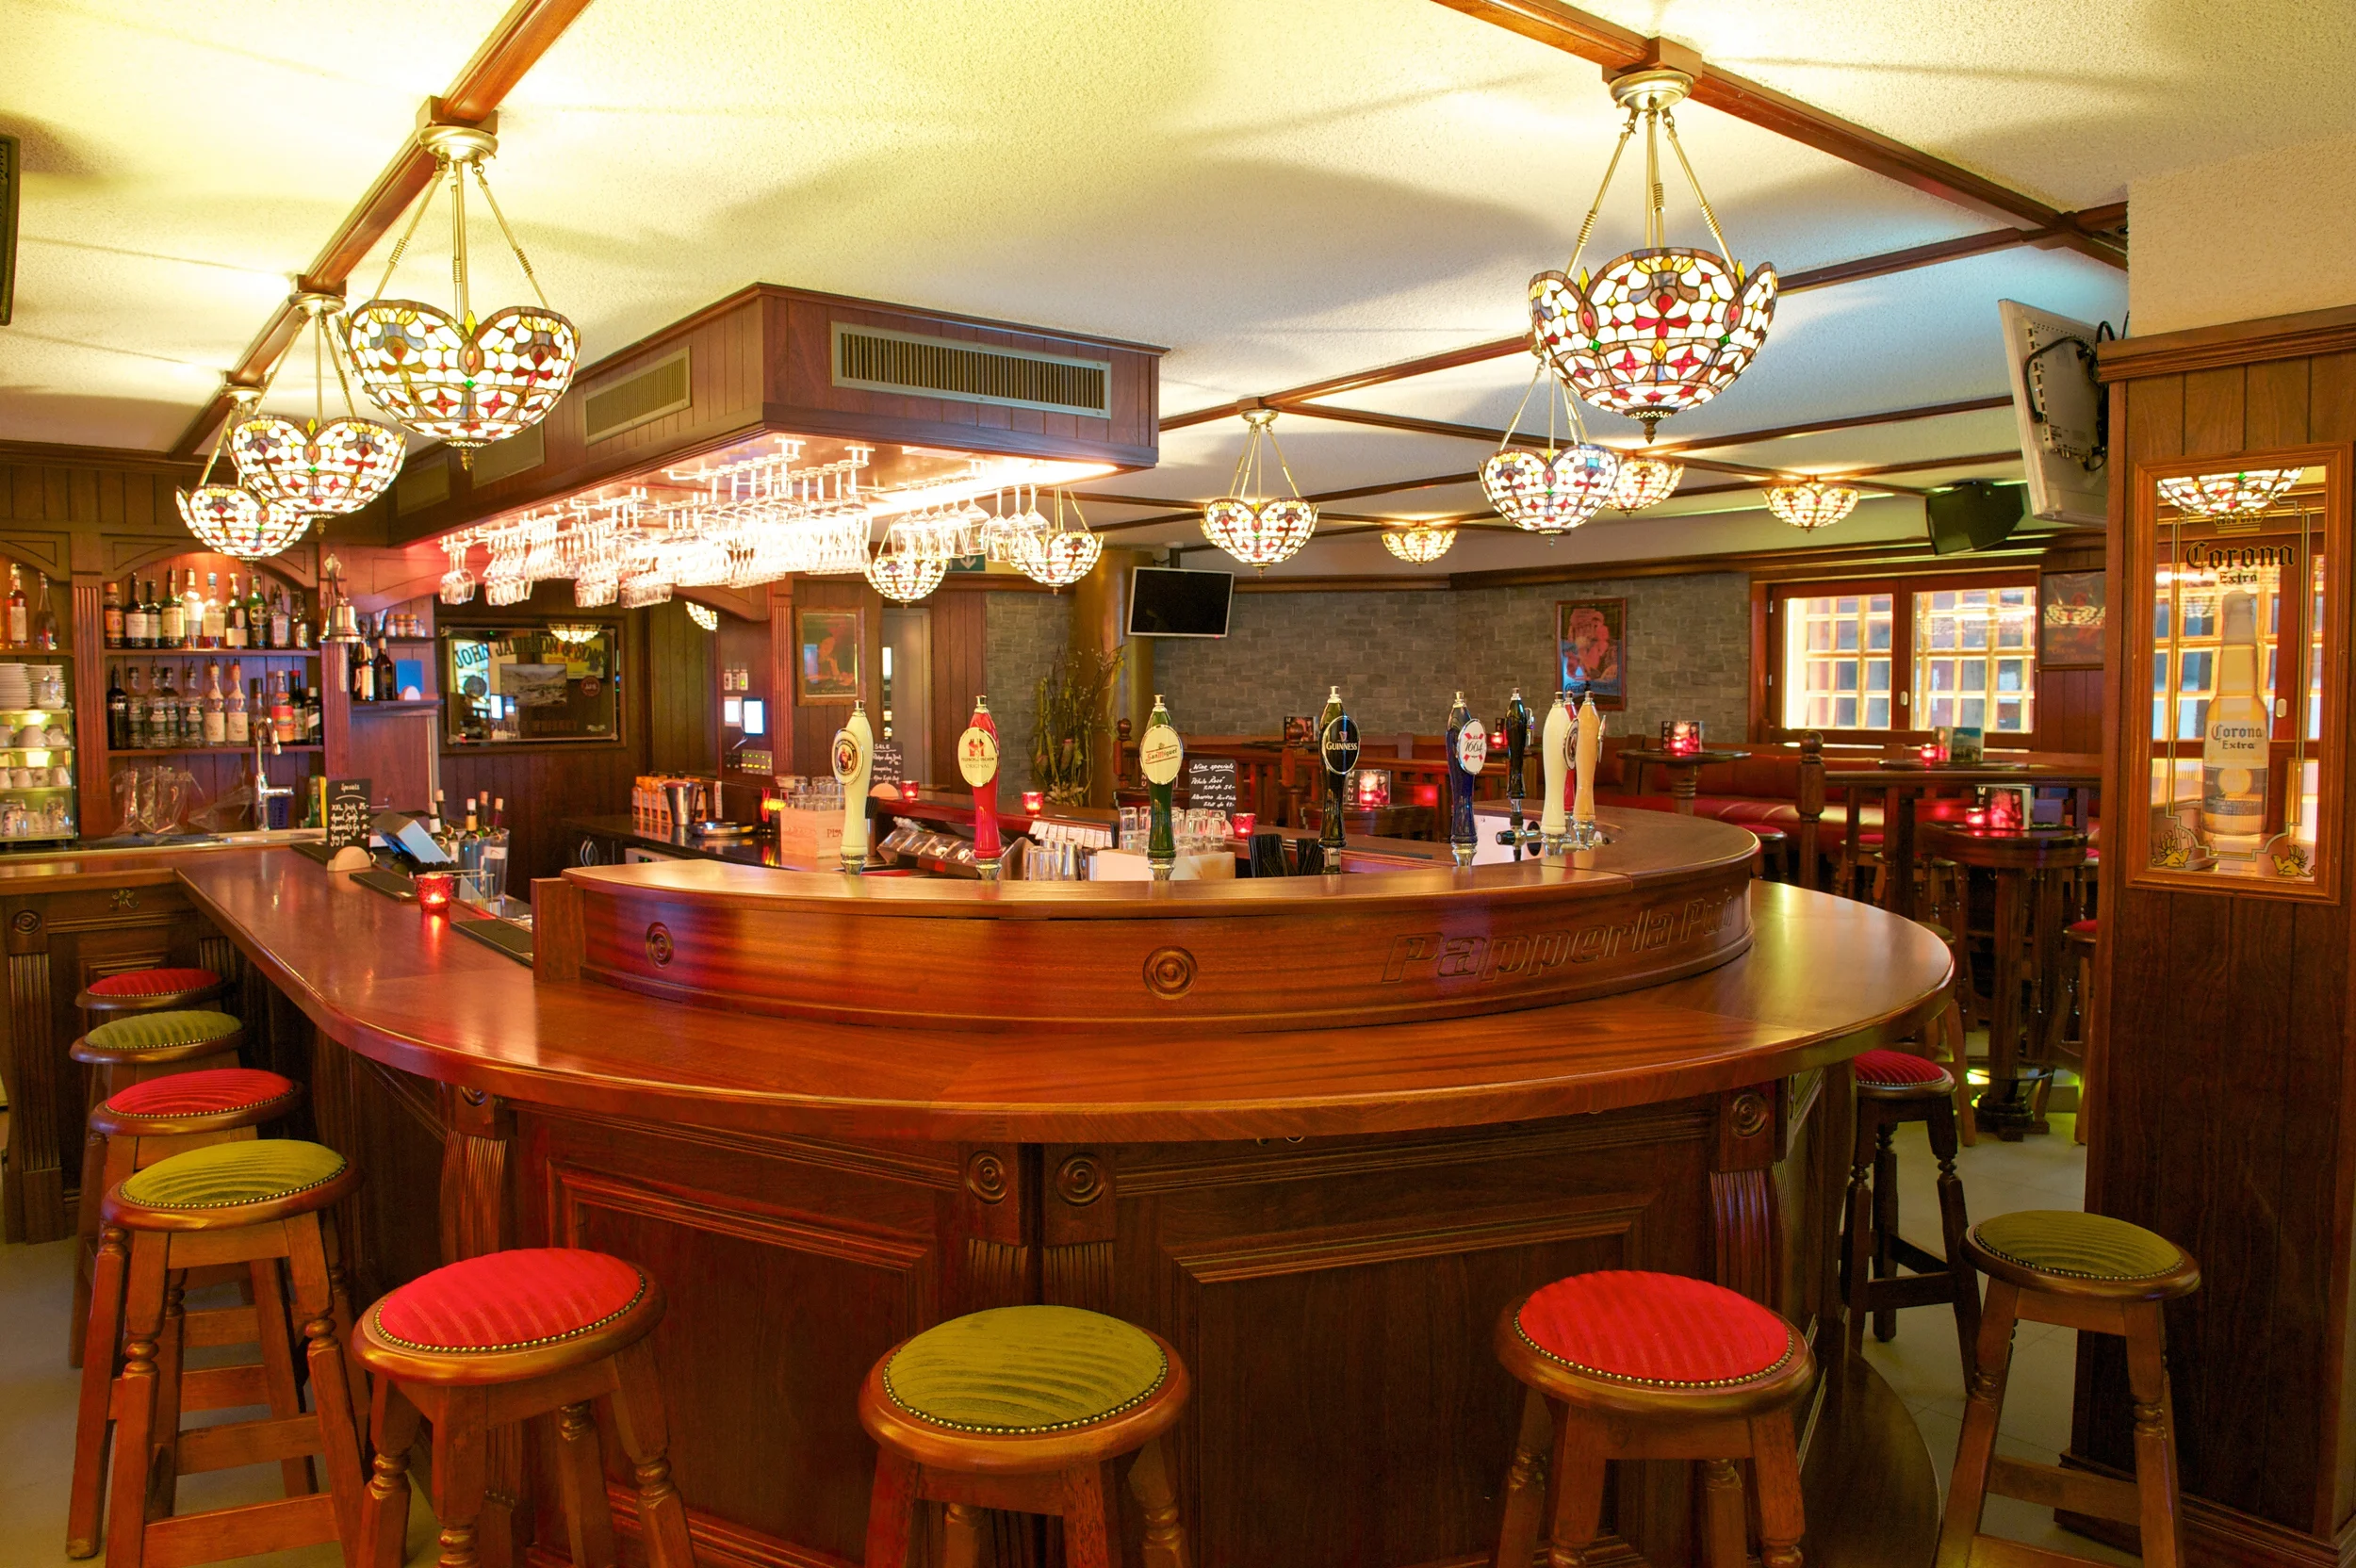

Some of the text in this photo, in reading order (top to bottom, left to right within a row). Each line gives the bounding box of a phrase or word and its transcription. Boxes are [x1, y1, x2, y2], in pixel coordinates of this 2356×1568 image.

[2185, 541, 2295, 576] Corona
[2219, 571, 2258, 584] Extra
[454, 643, 492, 669] JOHN
[2211, 724, 2264, 742] Corona
[1325, 741, 1358, 751] GUINNESS
[2221, 740, 2256, 751] Extra
[1192, 762, 1235, 773] Wine specials
[1347, 771, 1355, 802] MENU
[1381, 888, 1736, 983] Papperla Pub
